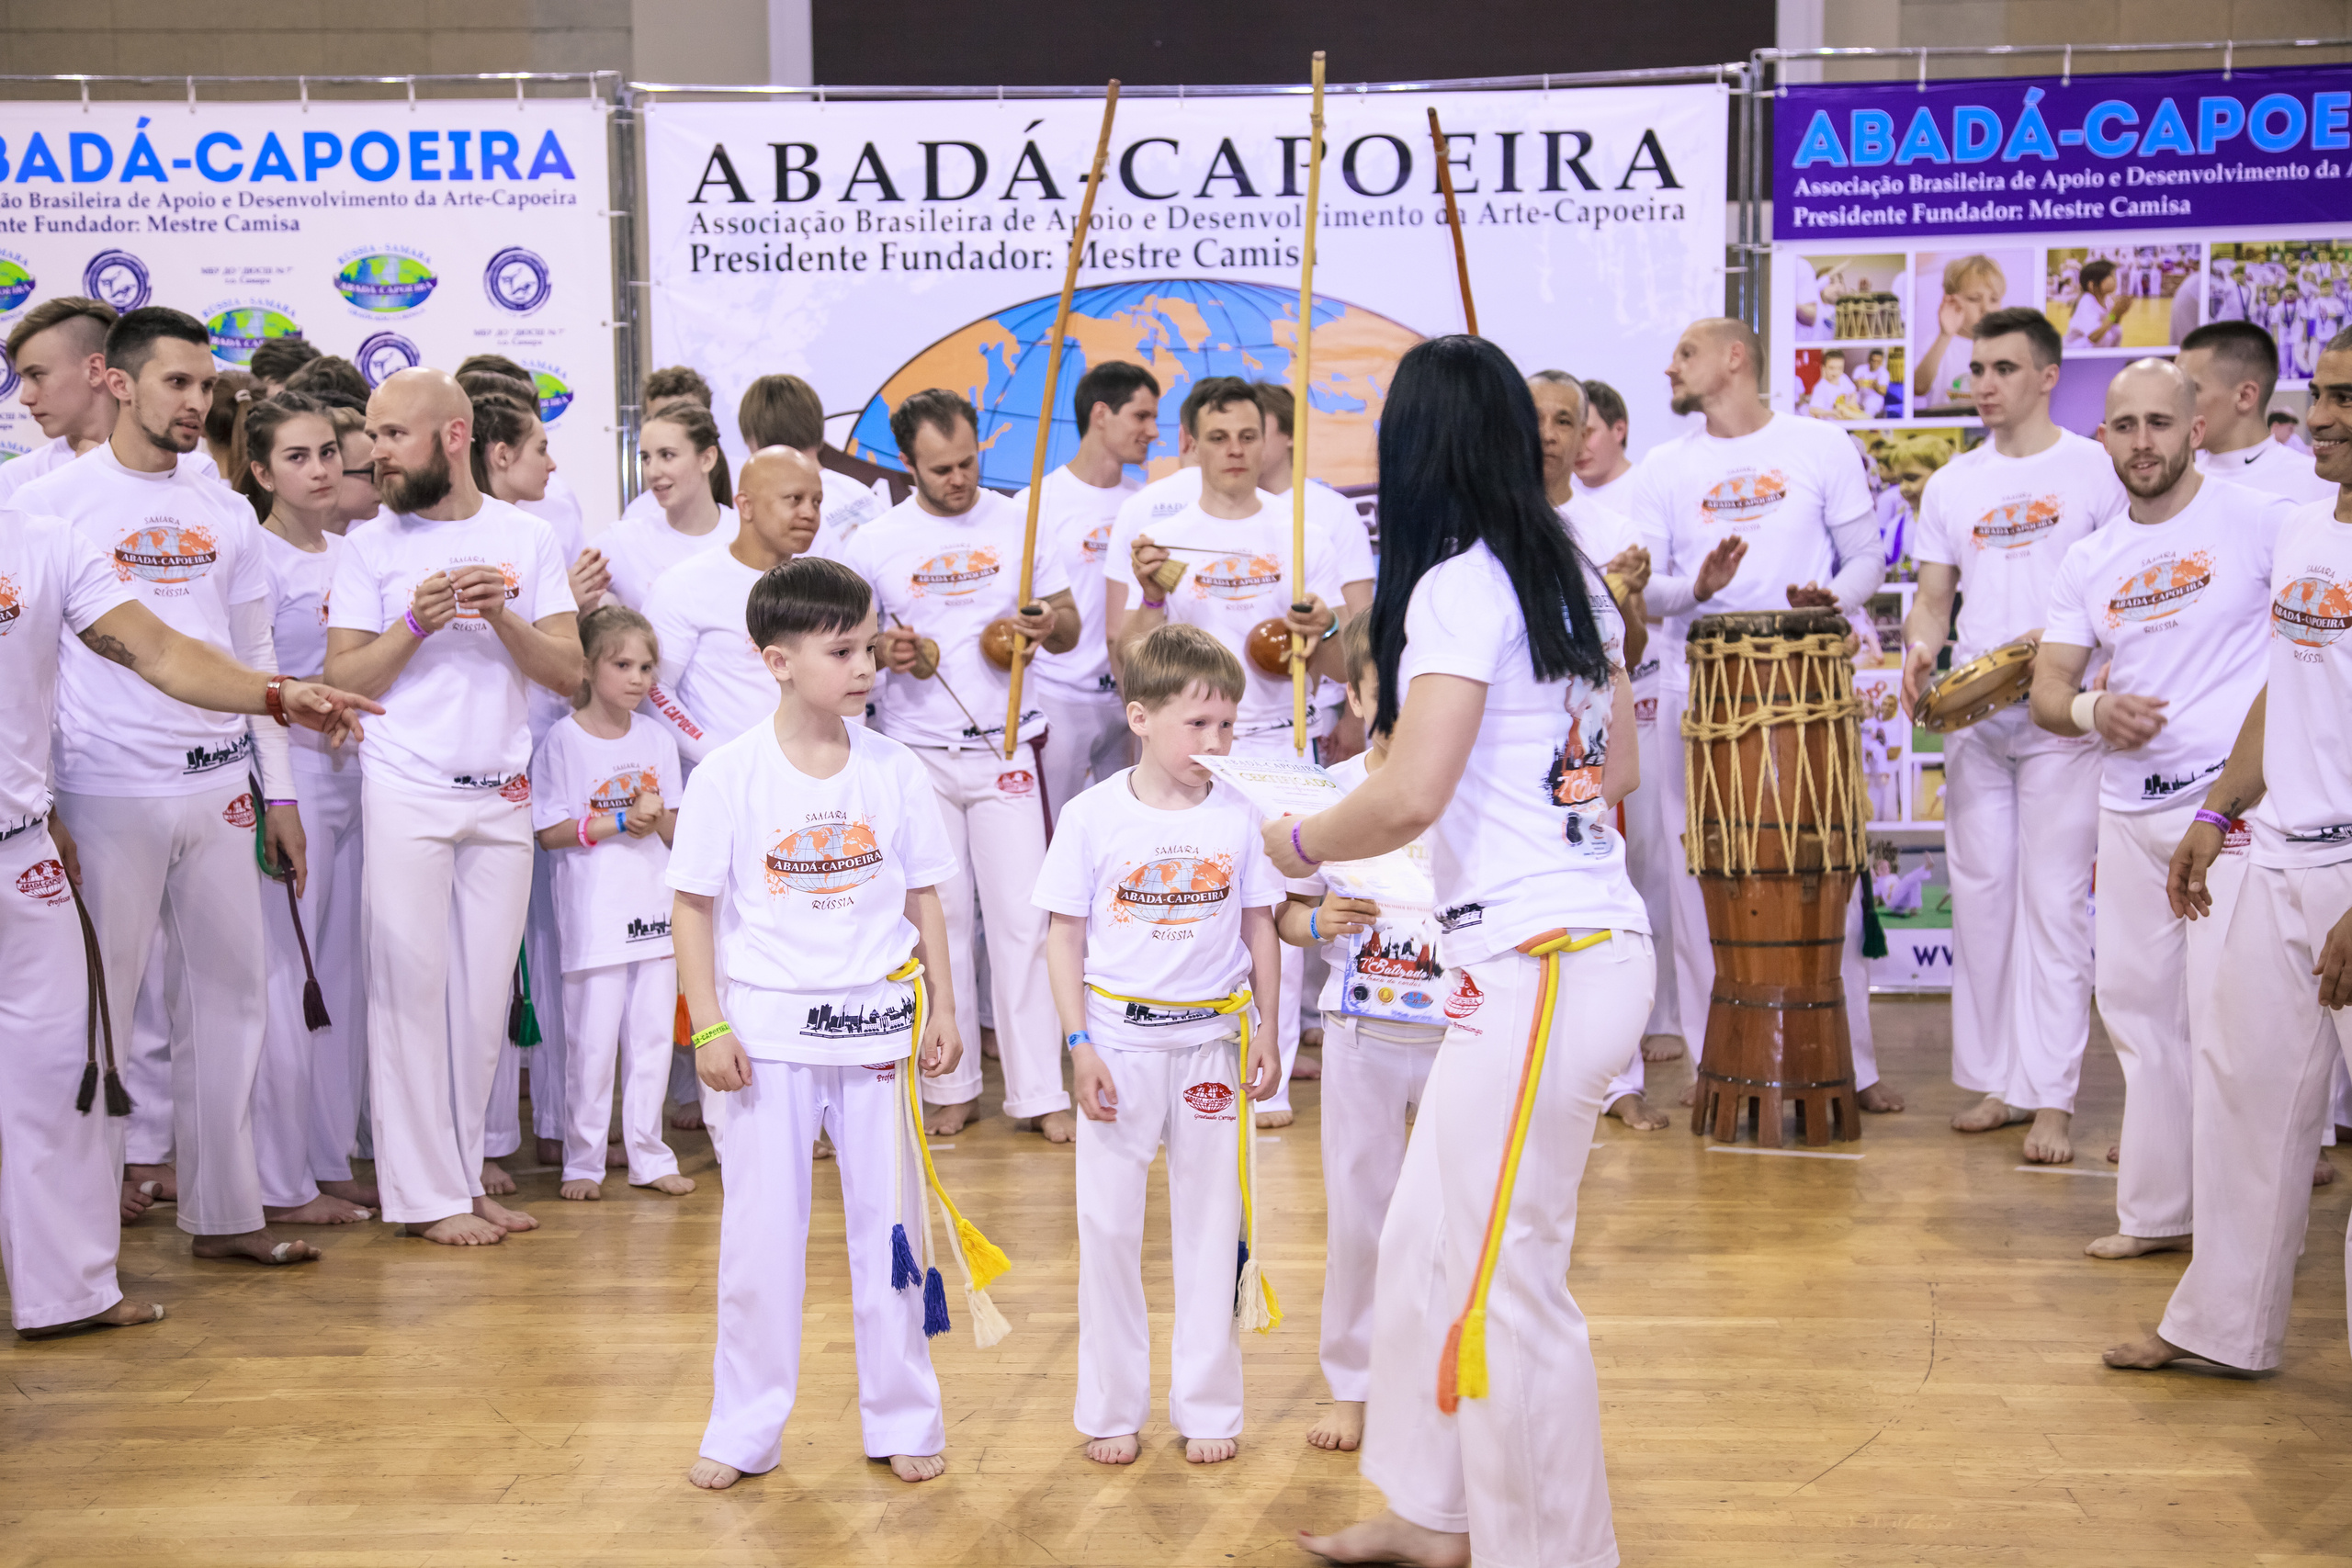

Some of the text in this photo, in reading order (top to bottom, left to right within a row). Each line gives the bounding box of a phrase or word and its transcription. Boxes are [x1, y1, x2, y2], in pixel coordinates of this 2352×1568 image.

[1792, 86, 2351, 168] ABADÁ-CAPOE
[688, 119, 1684, 204] ABADÁ-CAPOEIRA
[1793, 175, 1904, 199] Associação
[1908, 171, 2006, 194] Brasileira
[2010, 169, 2036, 190] de
[2041, 168, 2105, 194] Apoio
[2109, 172, 2121, 186] e
[2126, 162, 2309, 186] Desenvolvimento
[2314, 159, 2341, 179] da
[29, 191, 121, 209] Brasileira
[128, 191, 150, 209] de
[157, 191, 216, 212] Apoio
[222, 195, 232, 209] e
[238, 190, 408, 208] Desenvolvimento
[415, 189, 436, 206] da
[444, 188, 576, 210] Arte-Capoeira
[34, 215, 140, 232] Fundador:
[148, 215, 218, 231] Mestre
[225, 213, 300, 231] Camisa
[690, 210, 844, 240] Associação
[856, 208, 991, 231] Brasileira
[1003, 208, 1035, 231] de
[1144, 212, 1156, 230] e
[1168, 203, 1423, 230] Desenvolimento
[1477, 197, 1685, 230] Arte-Capoeira
[1793, 195, 2191, 228] Presidente Fundador: Mestre Camisa
[691, 242, 867, 273] Presidente
[880, 240, 1052, 271] Fundador:
[144, 515, 181, 526] SAMARA
[663, 706, 704, 740] CAPOEIRA
[805, 810, 847, 823] SAMARA
[774, 851, 882, 872] ABADÁ-CAPOEIRA
[1155, 845, 1199, 856] SAMARA
[811, 896, 854, 909] RÚSSIA
[1120, 889, 1225, 904] ABADÁ-CAPOEIRA
[1152, 928, 1193, 941] RÚSSIA
